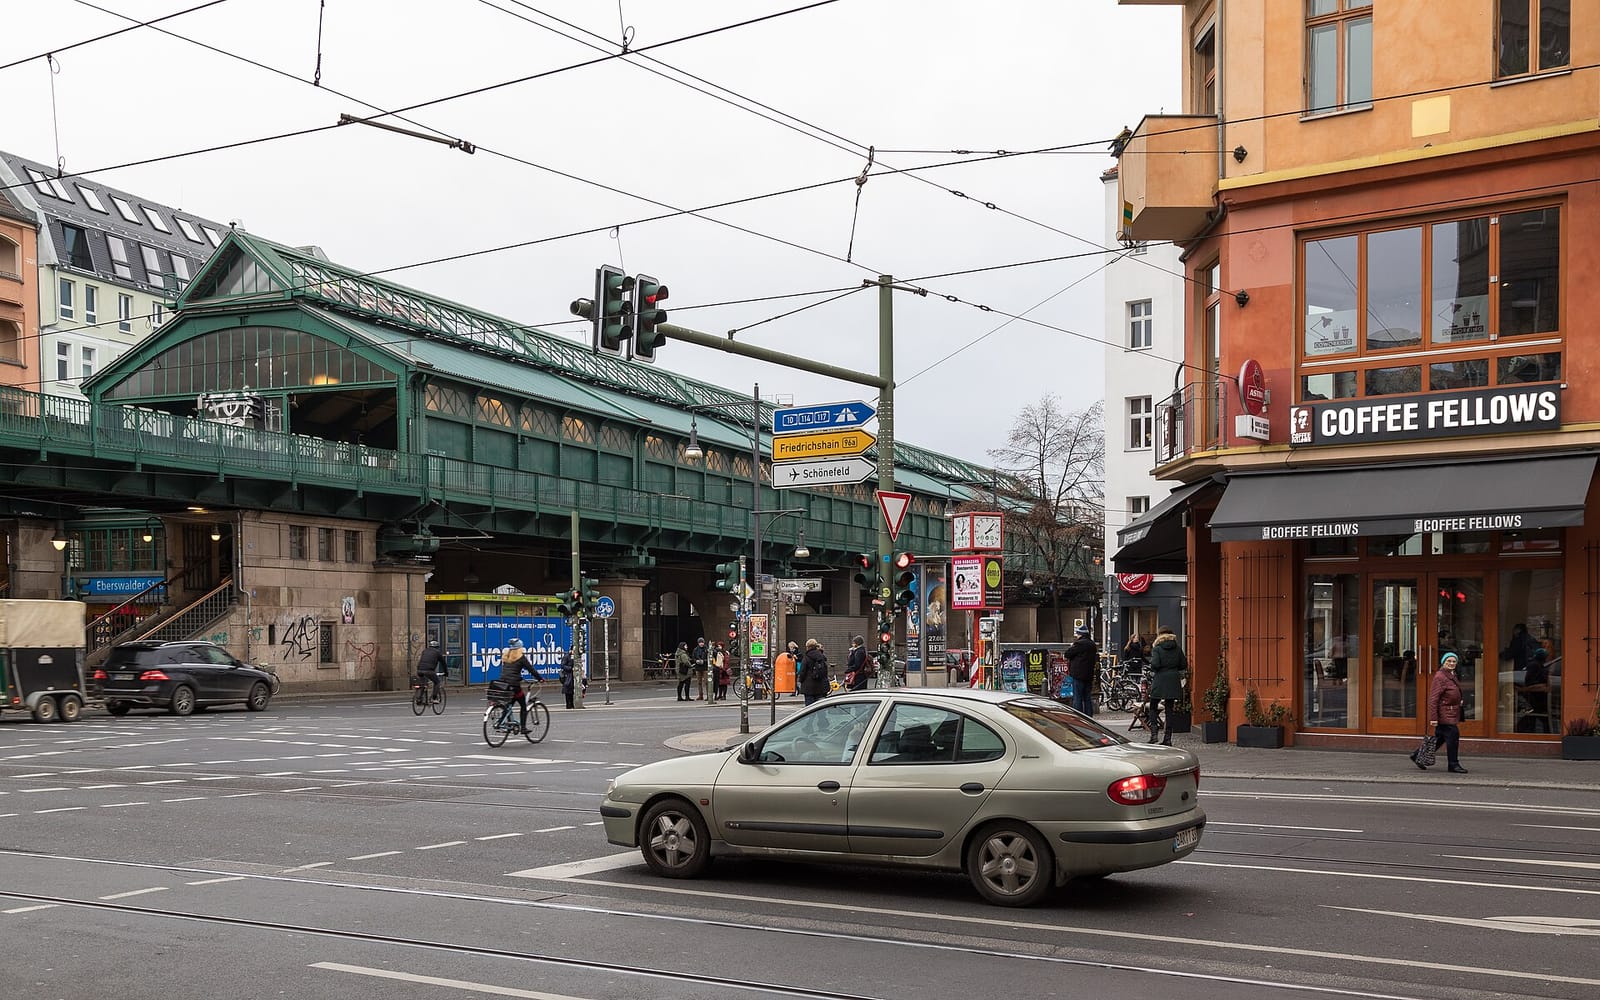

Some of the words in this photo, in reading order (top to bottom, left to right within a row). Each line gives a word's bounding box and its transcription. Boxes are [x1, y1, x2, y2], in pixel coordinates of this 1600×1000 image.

[1321, 402, 1419, 437] COFFEE
[1427, 391, 1557, 429] FELLOWS
[780, 440, 840, 453] Friedrichshain
[844, 438, 856, 447] 96a
[803, 466, 850, 479] Schönefeld
[1271, 526, 1309, 539] COFFEE
[1311, 523, 1359, 536] FELLOWS
[1424, 518, 1466, 532] COFFEE
[1469, 515, 1522, 529] FELLOWS
[96, 579, 145, 591] Eberswalder
[471, 641, 564, 673] Lycobile
